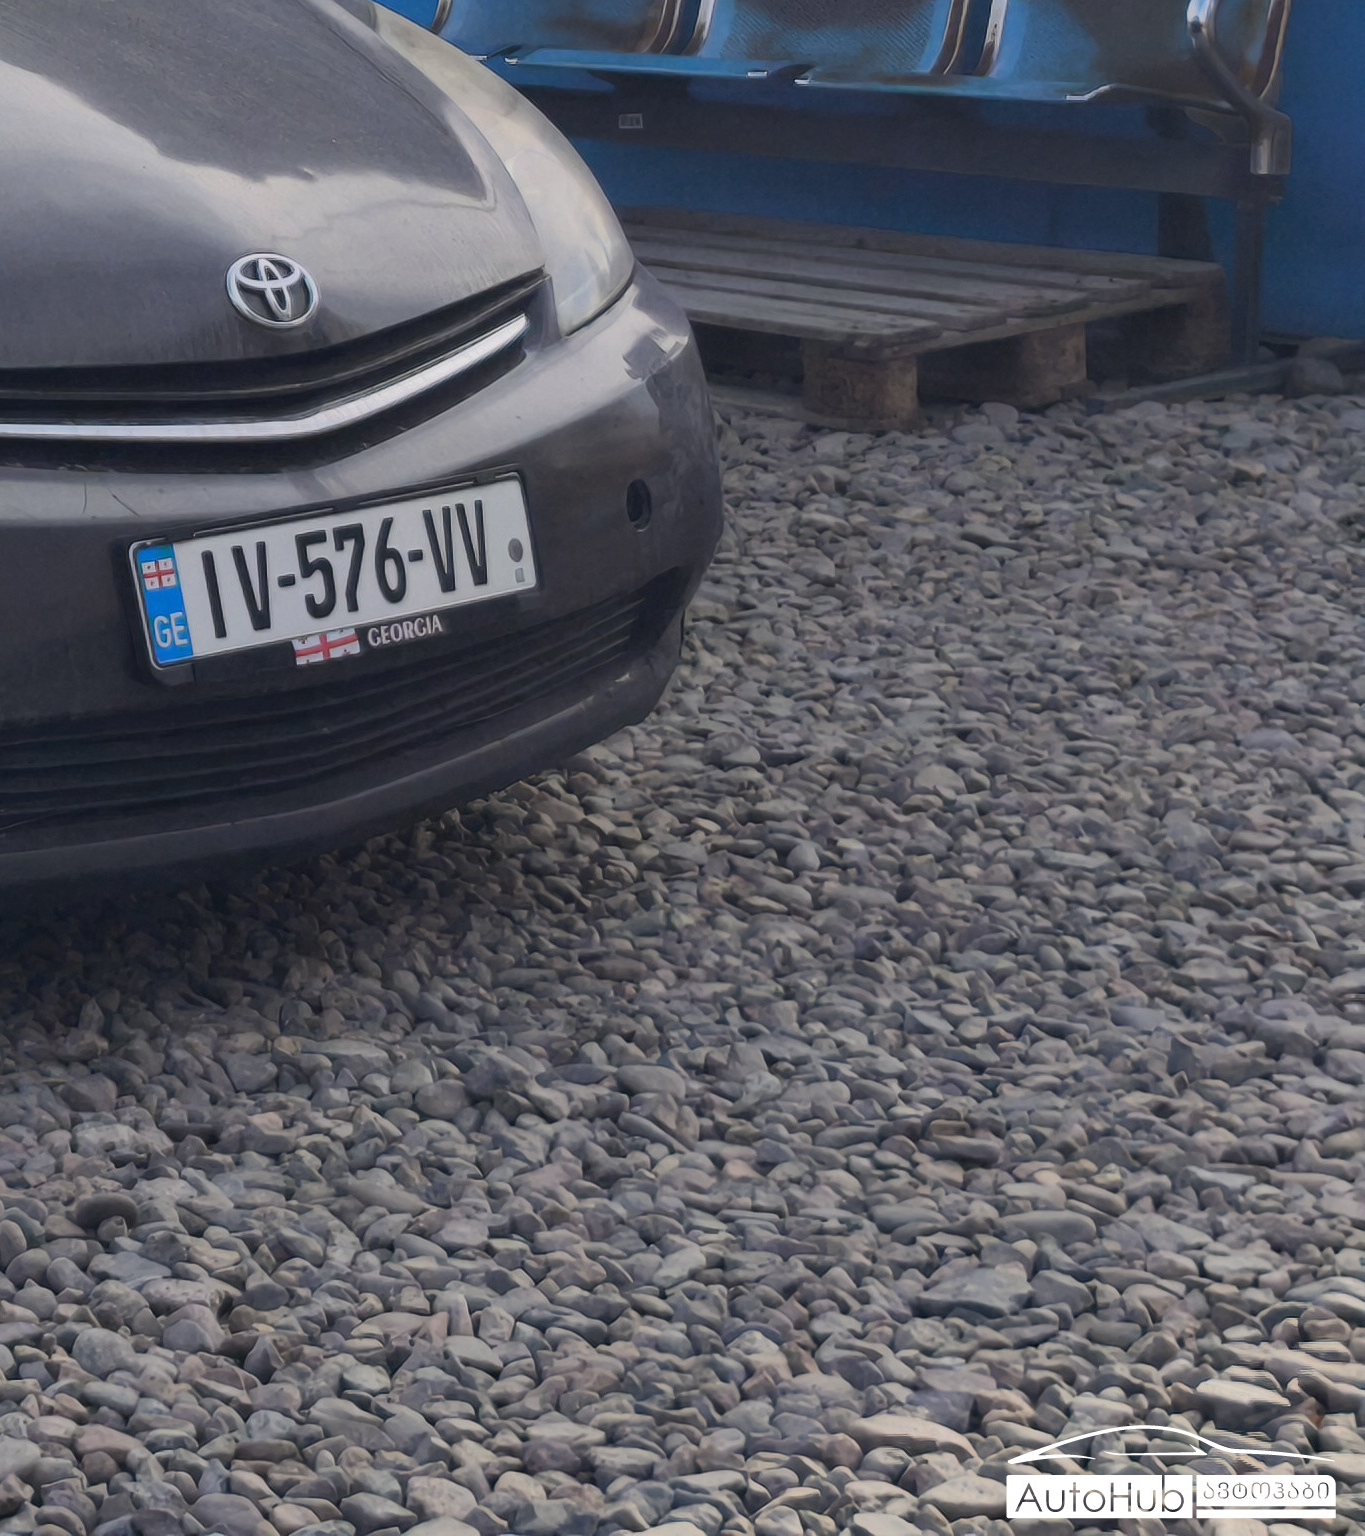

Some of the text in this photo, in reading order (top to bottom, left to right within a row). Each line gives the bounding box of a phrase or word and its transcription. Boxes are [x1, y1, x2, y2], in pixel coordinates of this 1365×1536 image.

[201, 499, 488, 639] IV-576-VV
[153, 611, 189, 649] GE
[367, 614, 444, 647] GEORGIA
